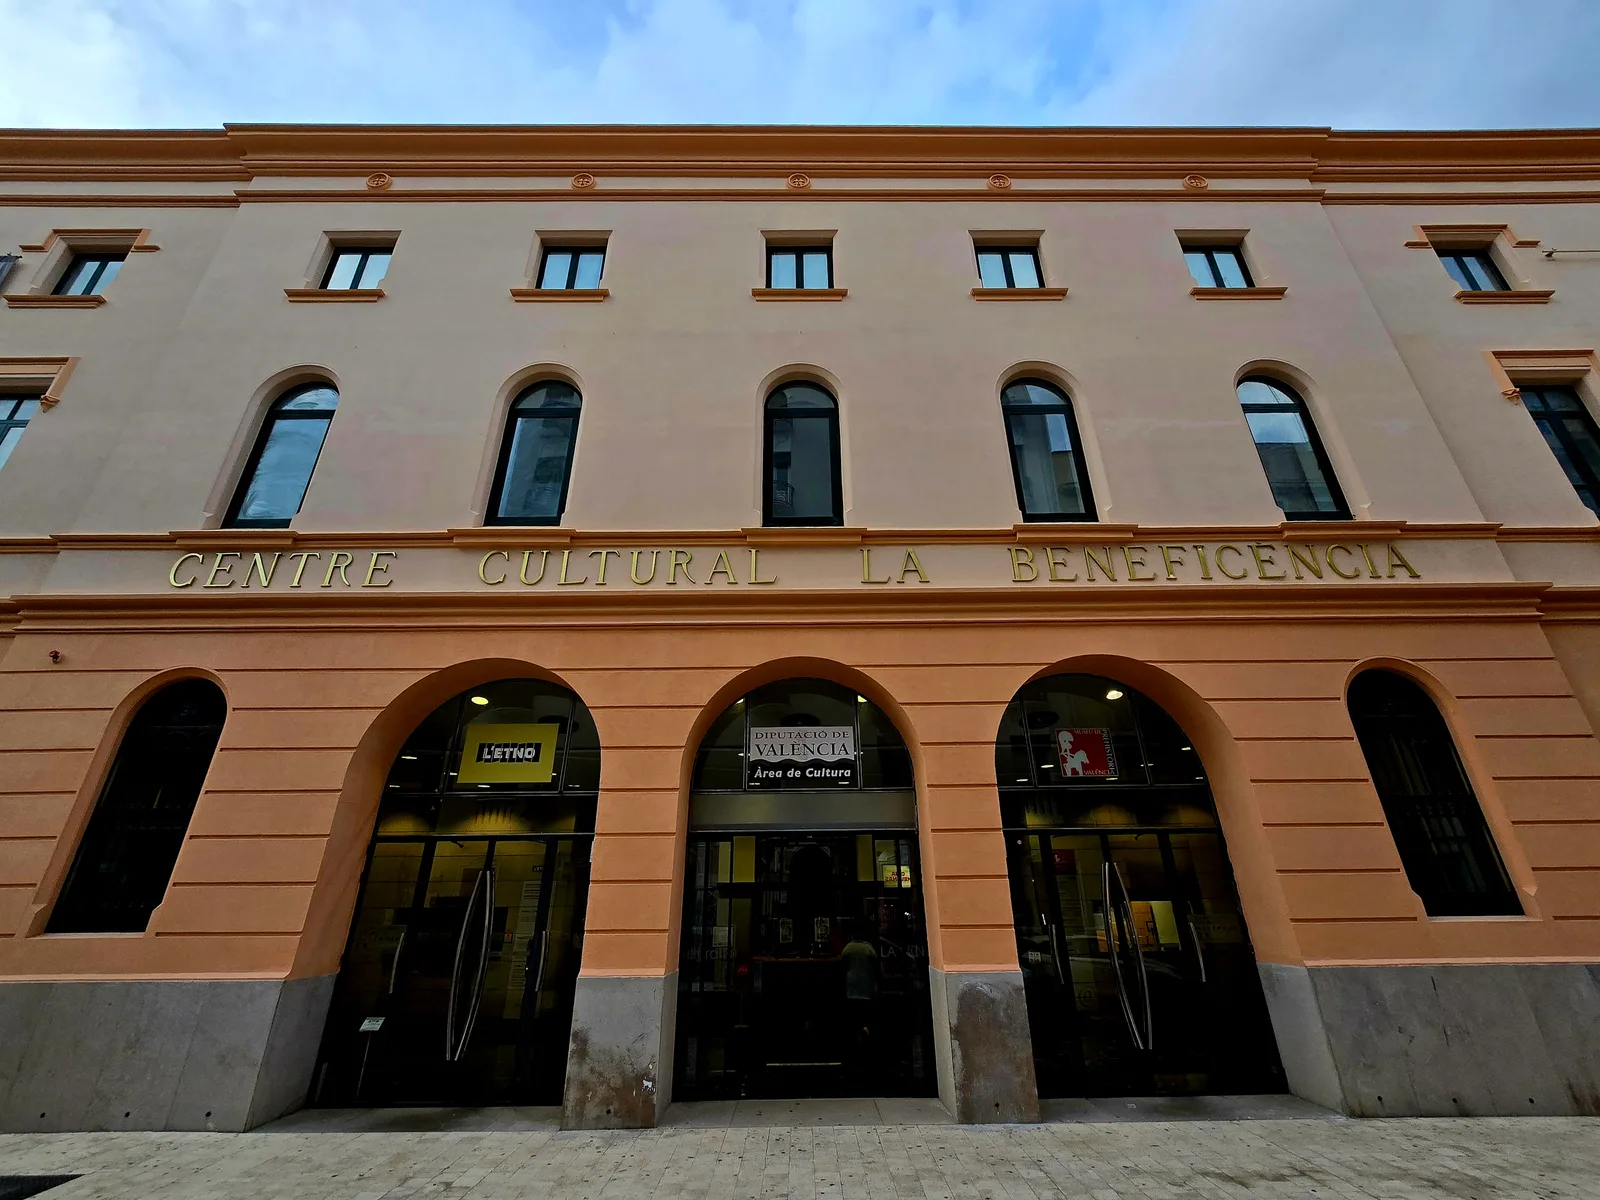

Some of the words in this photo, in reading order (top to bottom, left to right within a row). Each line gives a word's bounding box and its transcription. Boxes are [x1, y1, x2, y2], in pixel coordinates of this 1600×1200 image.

[168, 551, 397, 588] CENTRE
[478, 549, 777, 586] CULTURAL
[860, 547, 930, 584] LA
[1007, 542, 1421, 583] BENEFICÈNCIA
[755, 731, 828, 740] DIPUTACIÓ
[832, 731, 850, 739] DE
[482, 745, 536, 759] L'ETNO
[755, 741, 850, 756] VALÈNCIA
[787, 768, 801, 778] de
[805, 768, 851, 778] Cultura
